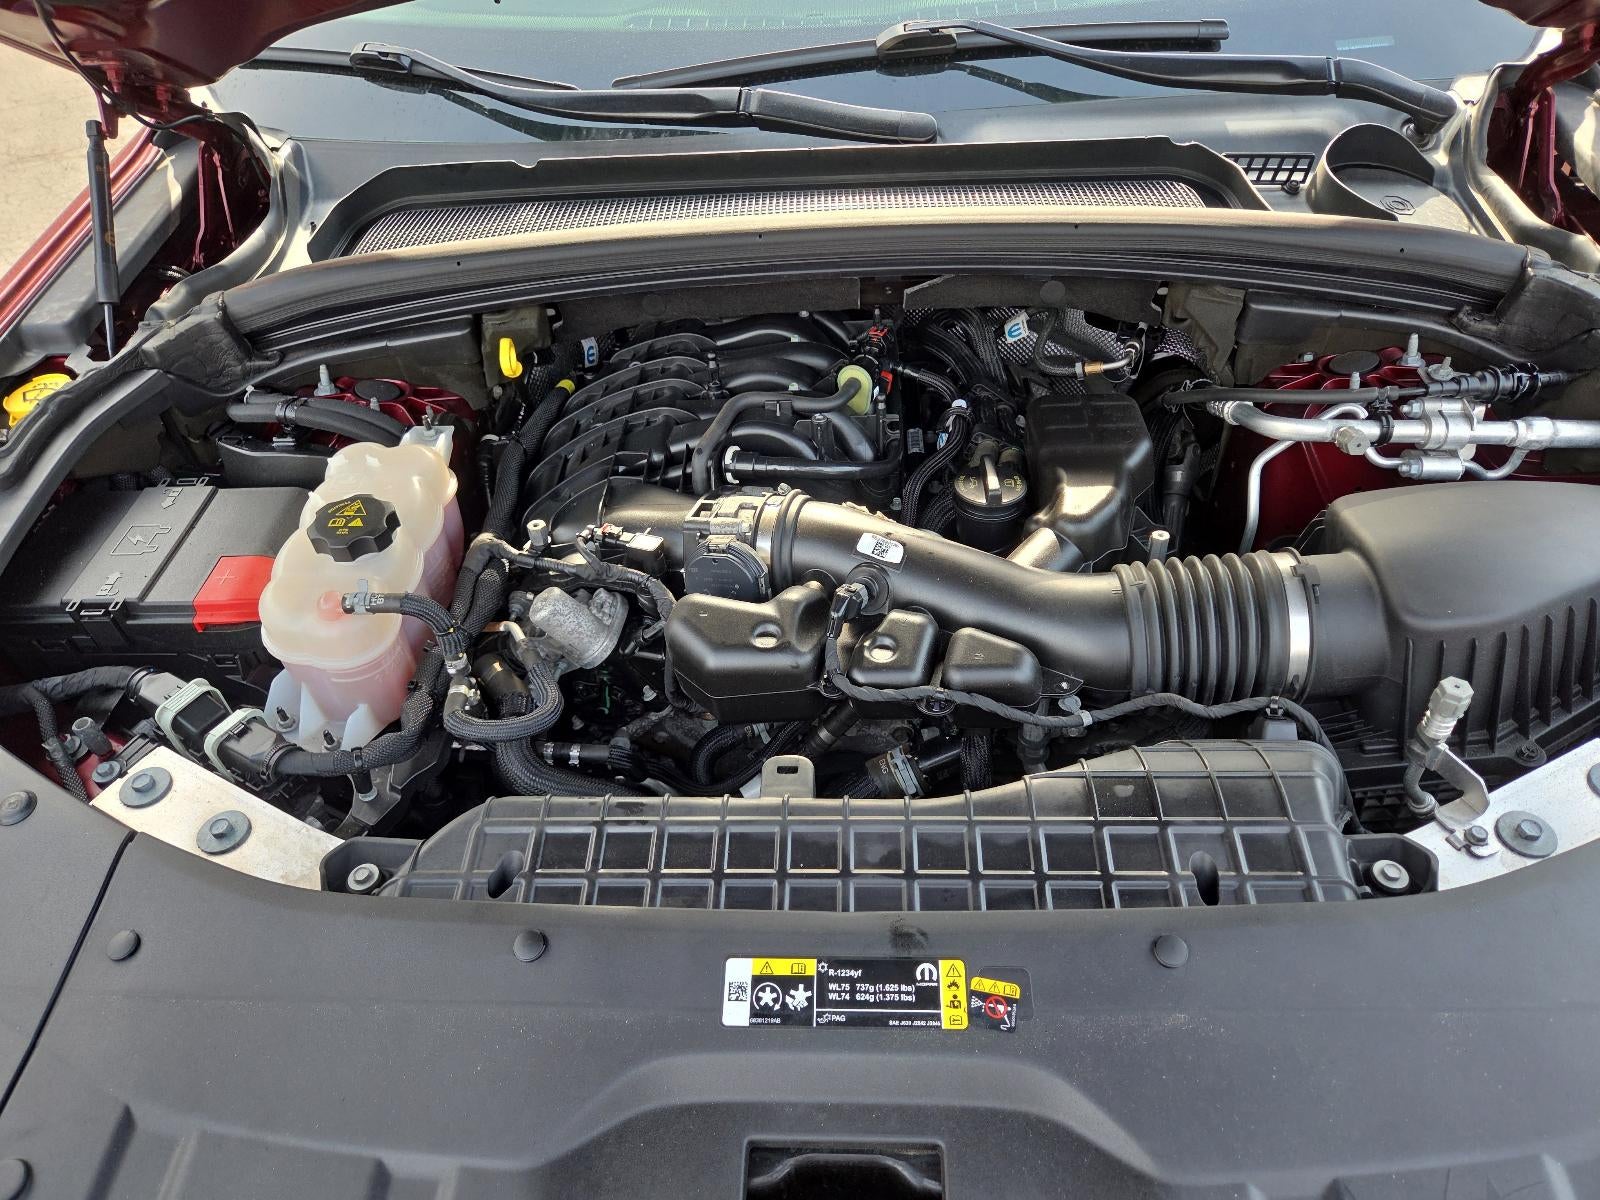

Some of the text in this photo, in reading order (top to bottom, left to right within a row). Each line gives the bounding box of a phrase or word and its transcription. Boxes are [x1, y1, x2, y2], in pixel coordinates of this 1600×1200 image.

[828, 968, 862, 978] R-1234yf
[828, 983, 916, 993] WL75 737g (1.625 lbs)
[828, 992, 916, 1003] WL74 624g (1.375 lbs)
[831, 1014, 846, 1022] PAG
